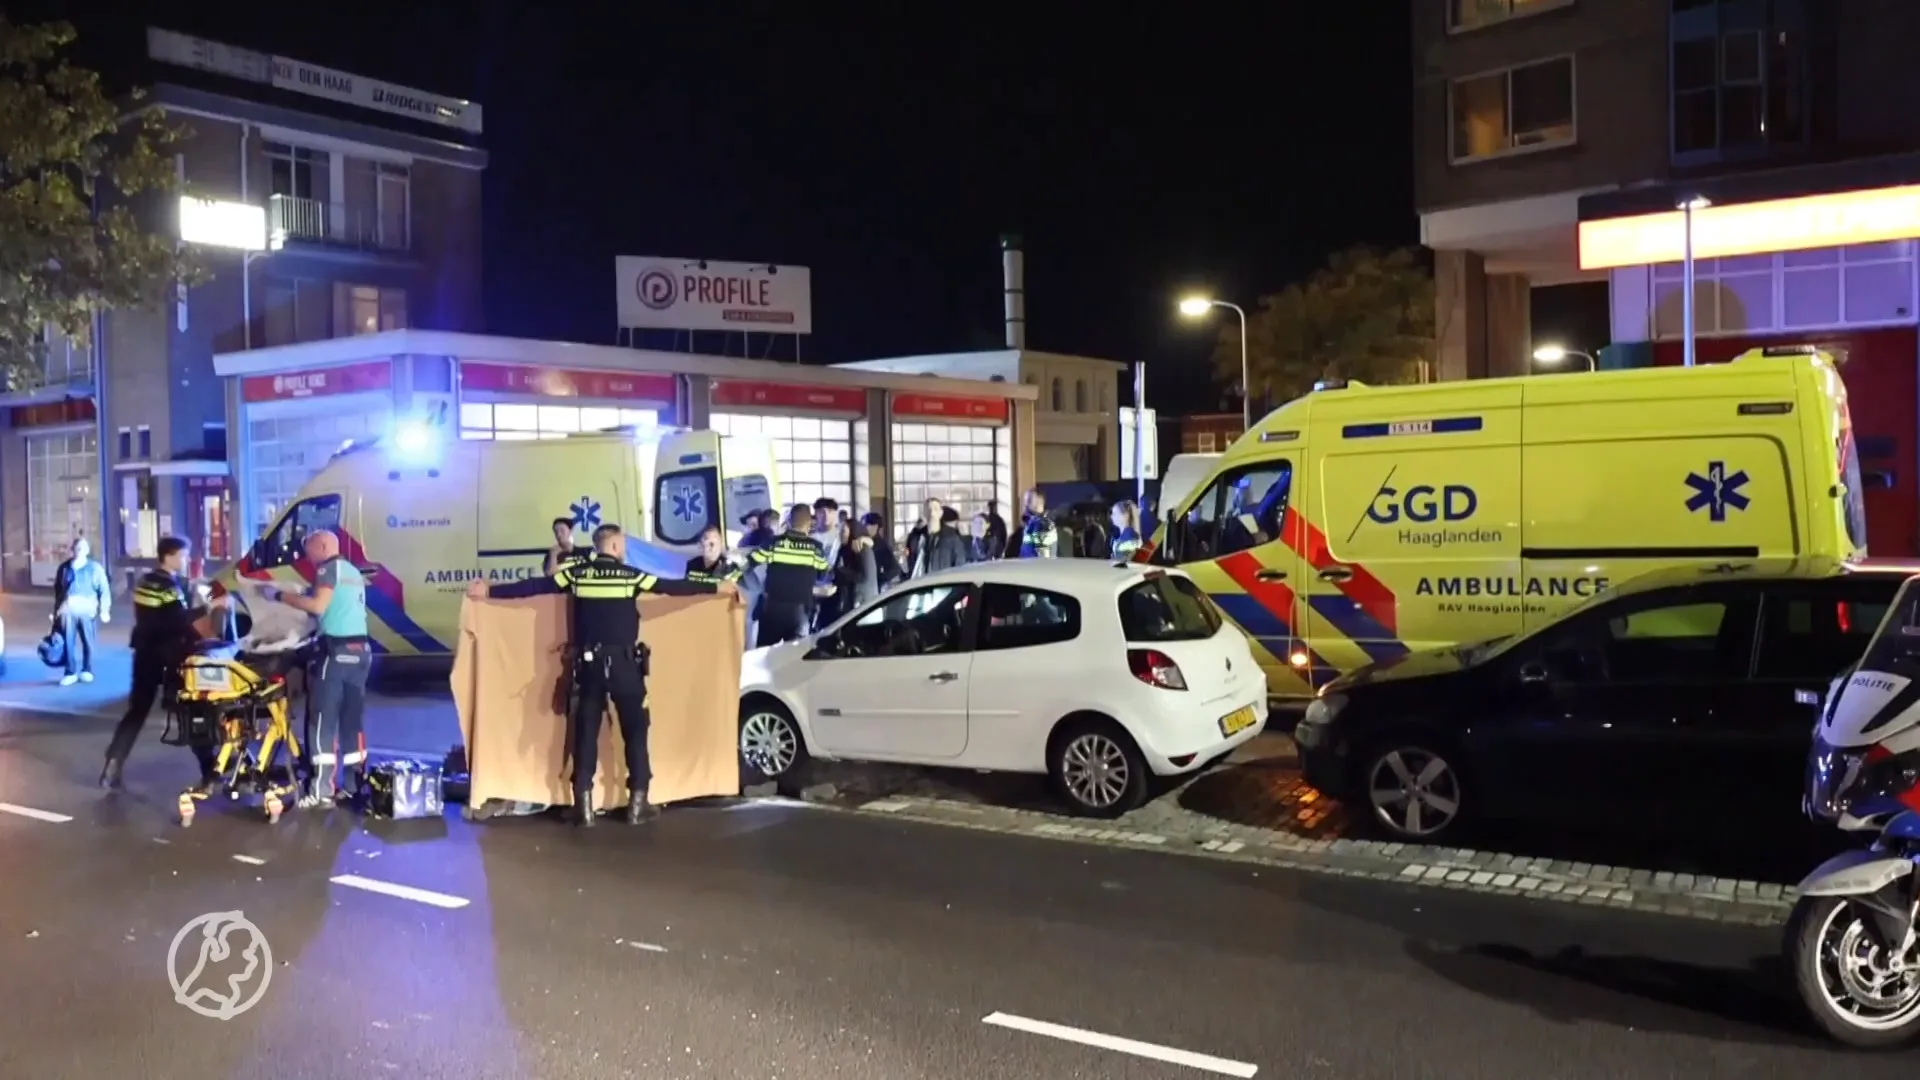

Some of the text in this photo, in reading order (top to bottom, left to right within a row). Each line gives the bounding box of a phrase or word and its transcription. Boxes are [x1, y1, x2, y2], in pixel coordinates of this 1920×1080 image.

[300, 67, 321, 86] DEN
[324, 73, 353, 94] HAAG
[684, 275, 771, 306] PROFILE
[1367, 485, 1478, 525] GGD
[1398, 528, 1503, 549] Haaglanden
[1415, 577, 1610, 597] AMBULANCE
[1438, 602, 1547, 615] RAV Haaglanden
[1852, 677, 1896, 692] POLITIE
